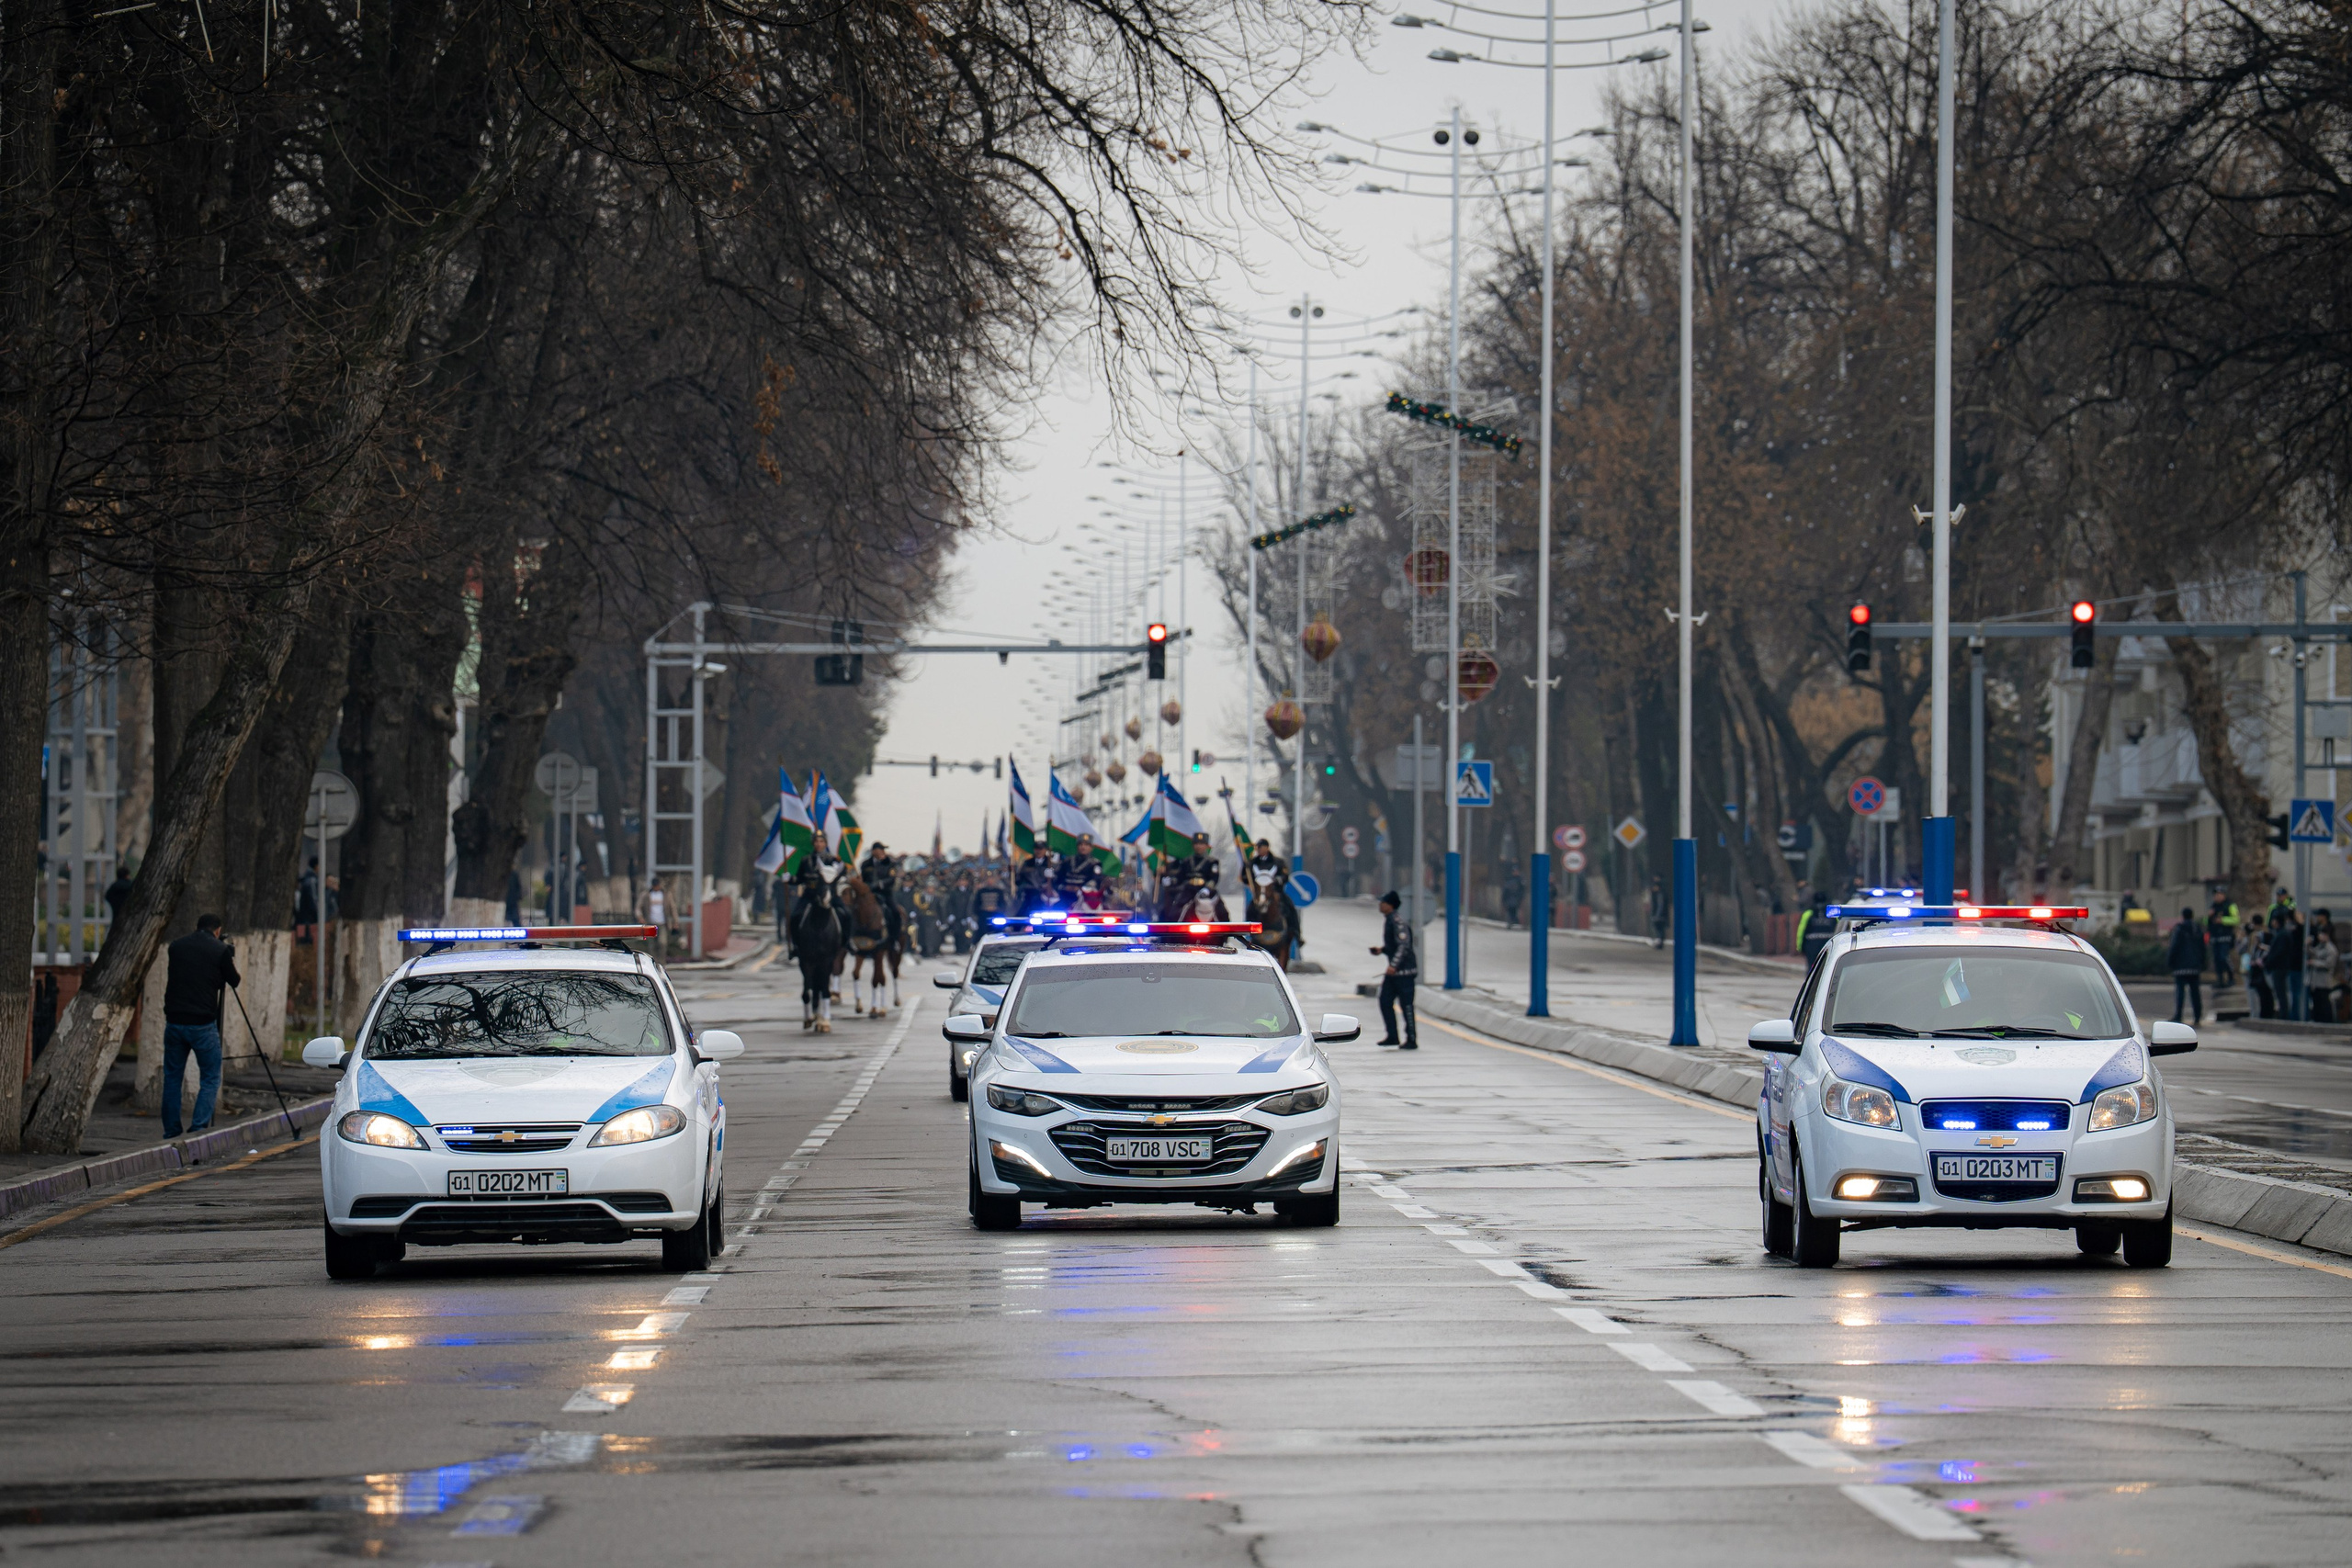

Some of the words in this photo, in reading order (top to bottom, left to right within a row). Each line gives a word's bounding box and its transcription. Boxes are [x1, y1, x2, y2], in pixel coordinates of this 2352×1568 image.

[1112, 1144, 1126, 1156] 01
[1130, 1142, 1160, 1157] 708
[1166, 1141, 1200, 1157] VSC
[1942, 1161, 1959, 1175] 01
[1967, 1159, 2014, 1178] 0203
[2017, 1159, 2042, 1178] MT
[454, 1176, 470, 1190] 01
[478, 1173, 524, 1191] 0202
[528, 1172, 554, 1190] MT
